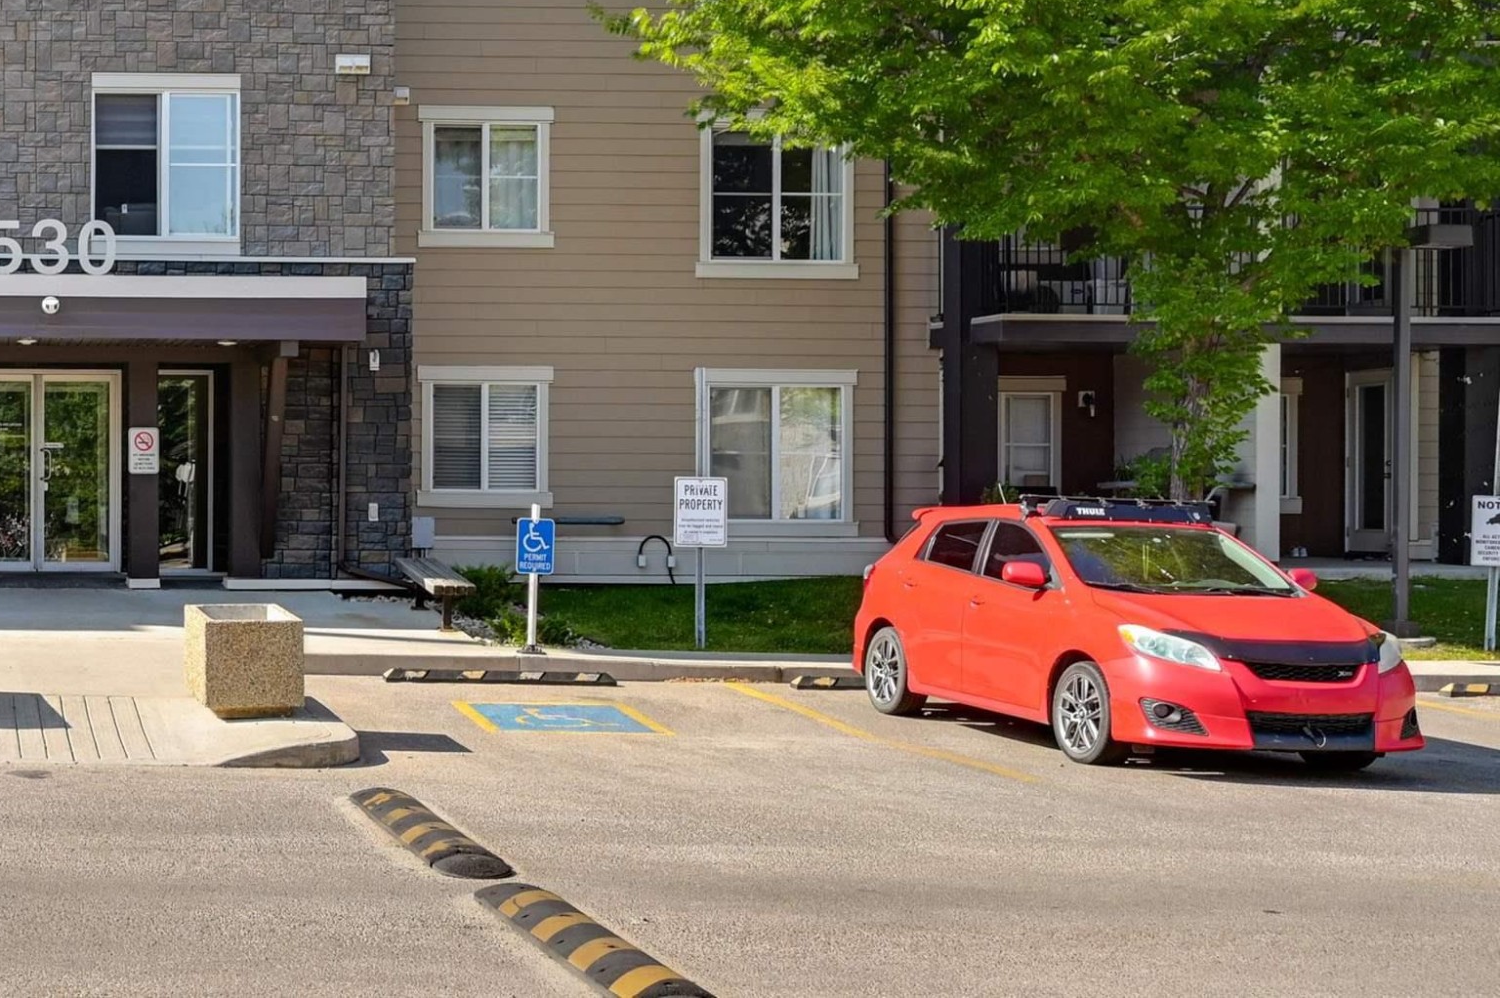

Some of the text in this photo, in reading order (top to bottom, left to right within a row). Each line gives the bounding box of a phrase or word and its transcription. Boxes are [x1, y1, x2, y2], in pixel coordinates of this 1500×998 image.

[684, 484, 718, 496] PRIVATE
[679, 498, 723, 510] PROPERTY
[1076, 507, 1105, 516] THULE
[524, 553, 547, 561] PERMIT
[519, 562, 551, 570] REQUIRED
